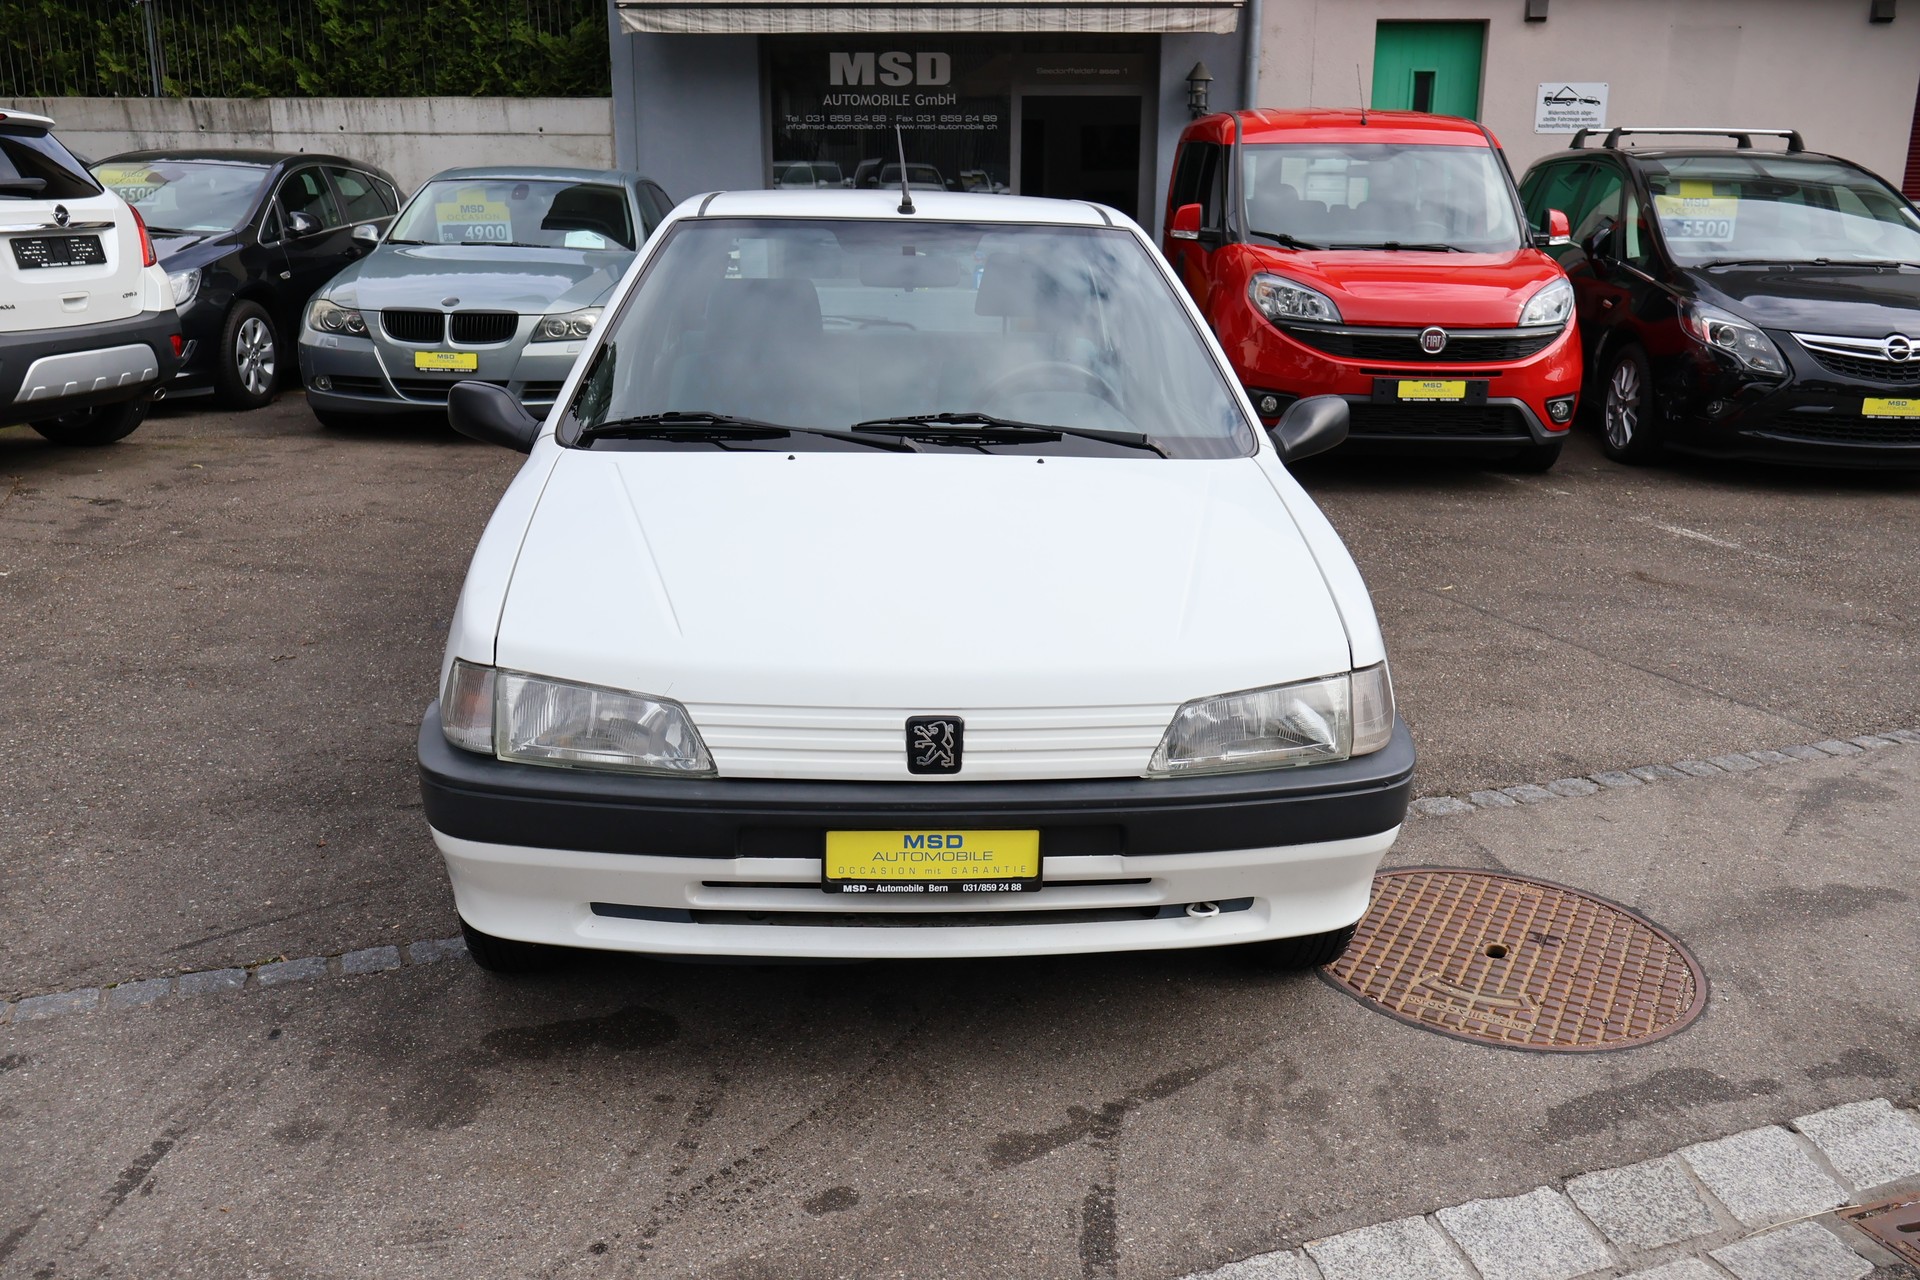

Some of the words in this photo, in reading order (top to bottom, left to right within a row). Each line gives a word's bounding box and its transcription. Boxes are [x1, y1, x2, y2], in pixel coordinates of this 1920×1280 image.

[829, 51, 951, 87] MSD
[823, 94, 910, 106] AUTOMOBILE
[914, 94, 956, 106] GmbH
[785, 114, 802, 122] Tel.
[805, 114, 825, 123] 031
[829, 114, 852, 123] 859
[854, 114, 869, 122] 24
[872, 114, 887, 122] 88
[896, 114, 913, 122] Fax
[916, 114, 936, 122] 031
[940, 114, 962, 122] 859
[965, 114, 980, 122] 24
[982, 114, 998, 122] 89
[1682, 198, 1710, 207] MSD
[460, 204, 485, 213] MSD
[446, 213, 500, 221] OCCASION
[464, 225, 506, 240] 4900
[1680, 220, 1729, 237] 5500
[1426, 335, 1441, 348] FIAT
[903, 834, 964, 849] MSD
[872, 851, 994, 862] AUTOMOBILE
[838, 866, 916, 875] OCCASION
[951, 865, 1027, 875] GARANTIE
[928, 883, 949, 892] Bern
[962, 883, 997, 893] 031/859
[998, 883, 1009, 891] 24
[1011, 883, 1022, 891] 88
